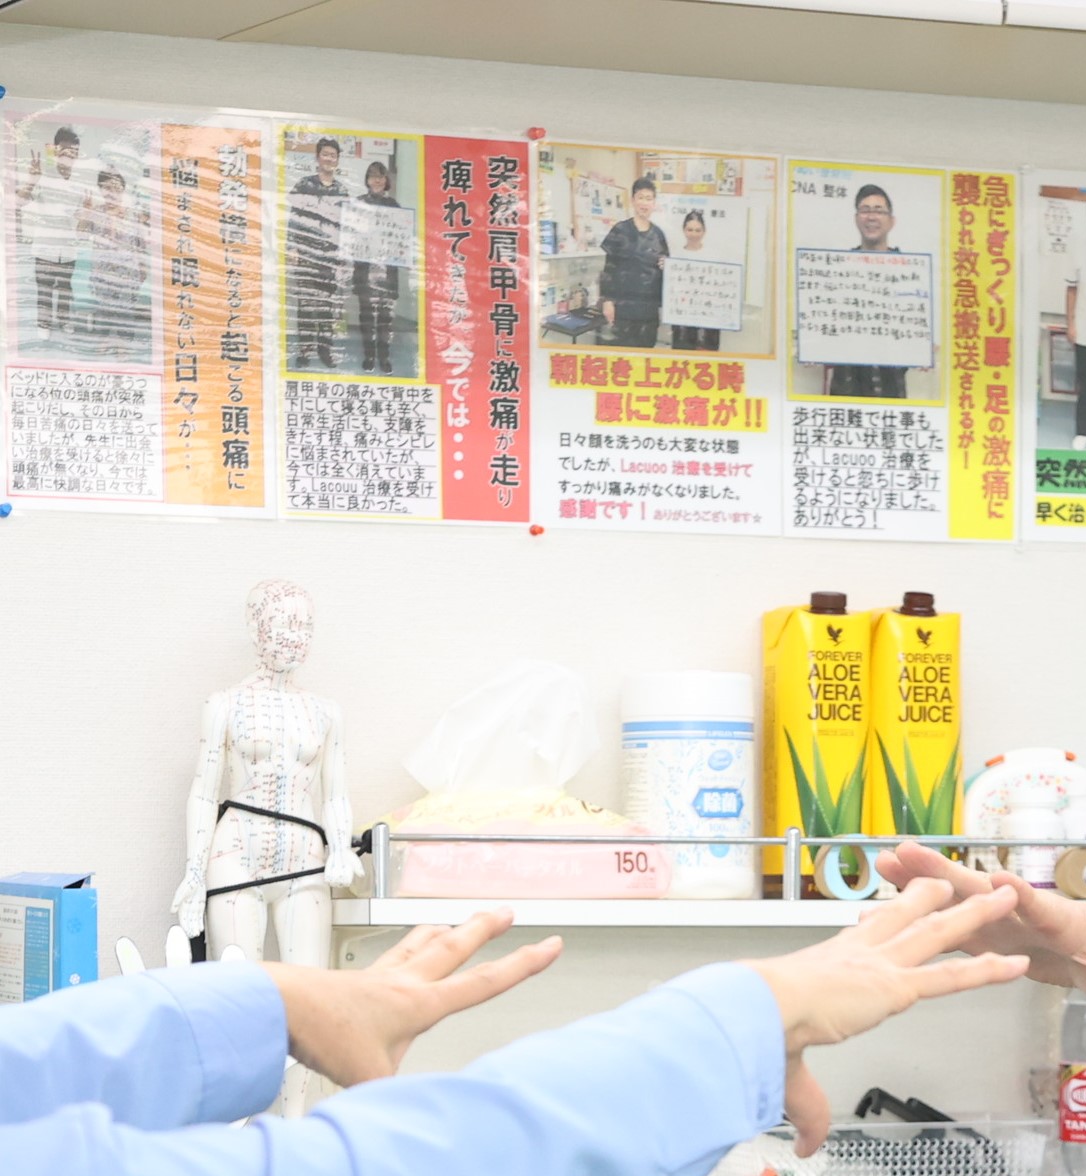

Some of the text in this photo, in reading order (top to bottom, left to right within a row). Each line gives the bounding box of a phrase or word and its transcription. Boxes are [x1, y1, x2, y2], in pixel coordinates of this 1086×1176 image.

[488, 156, 520, 507] 突然肩甲骨に激痛が走り
[983, 175, 1013, 519] 急にぎっくり腰・足の激痛に
[550, 354, 745, 393] 朝起き上がる時
[287, 414, 426, 435] 日常生活にも、支障を
[793, 407, 931, 430] 歩行困難で仕事も
[559, 432, 740, 454] 日々顔を洗うのも大変な状態
[793, 427, 944, 450] 出来ない状態でした
[286, 446, 419, 466] に悩まされていたが、
[882, 450, 931, 470] 治療を
[286, 461, 425, 480] 今では全く消えていま
[672, 460, 753, 478] 治療を受けて
[794, 466, 939, 490] 受けると忽ちに歩け
[362, 480, 434, 498] 治療を受け
[559, 480, 741, 501] すっかり痛みがなくなりました。
[794, 487, 936, 511] るようになりました。
[287, 494, 408, 513] て本当に良かった。
[808, 651, 863, 661] FOREVER
[898, 653, 952, 664] FOREVER
[808, 663, 861, 681] ALOE
[898, 666, 951, 683] ALOE
[808, 683, 862, 701] VERA
[898, 686, 952, 703] VERA
[807, 703, 863, 721] JUICE
[898, 705, 953, 723] JUICE
[703, 791, 738, 814] 除菌
